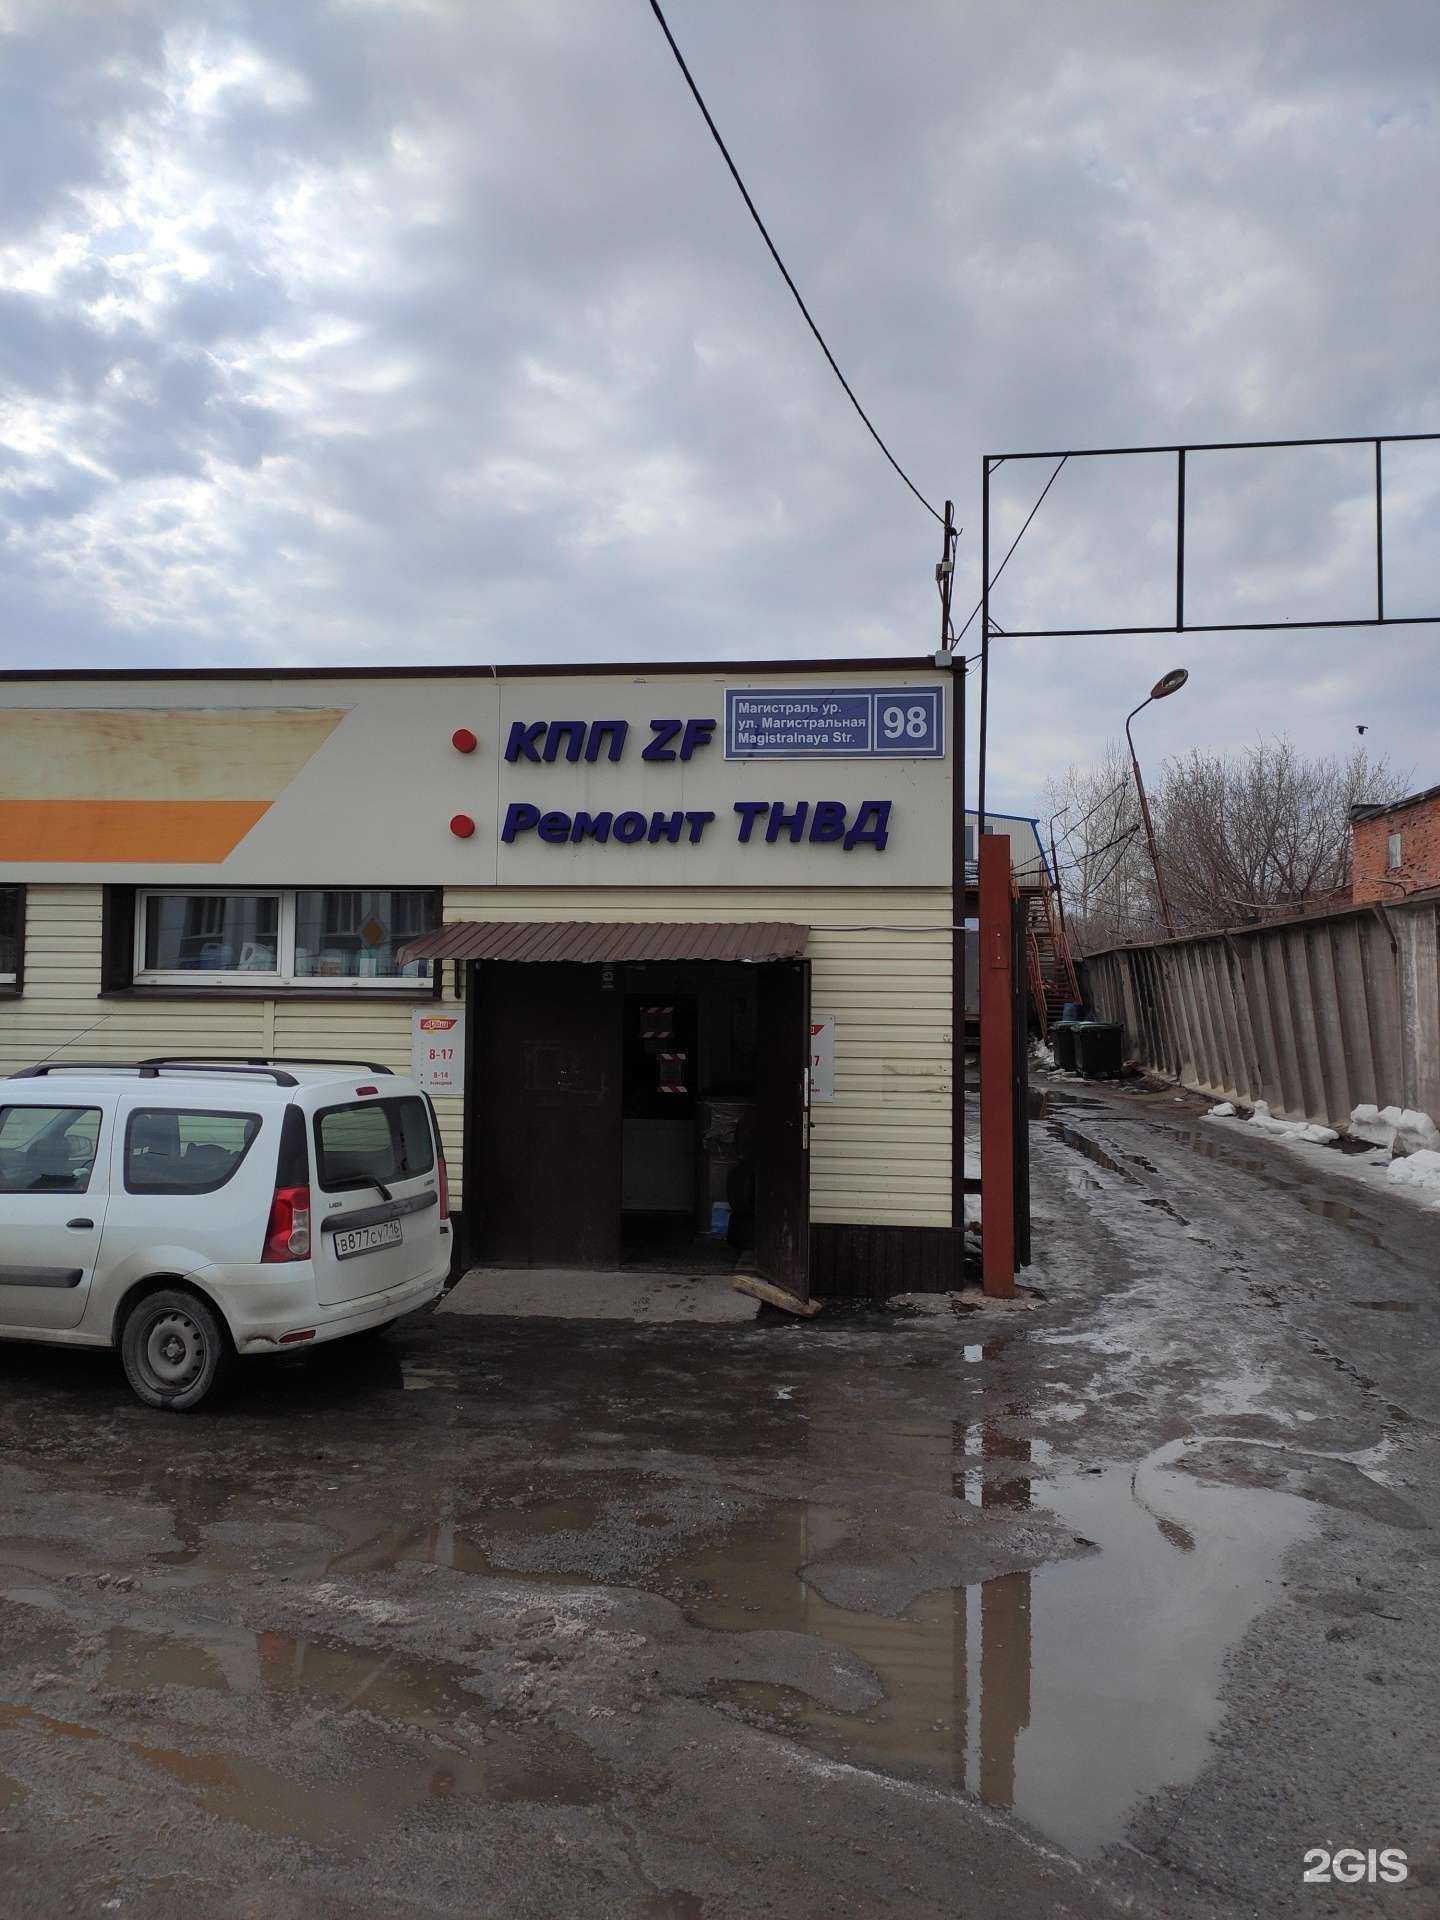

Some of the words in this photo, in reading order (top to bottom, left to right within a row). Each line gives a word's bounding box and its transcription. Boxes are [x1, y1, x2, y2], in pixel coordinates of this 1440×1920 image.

[738, 702, 819, 714] Магистраль
[822, 703, 842, 716] ур.
[738, 719, 758, 731] ул.
[761, 717, 866, 731] Магистральная
[883, 706, 928, 738] 98
[504, 720, 629, 762] КПП
[642, 719, 717, 762] ZF
[738, 731, 829, 746] Magistralnaya
[832, 731, 855, 743] Str.
[501, 803, 716, 844] Ремонт
[733, 801, 892, 851] ТНВД
[429, 1048, 454, 1060] 8-17
